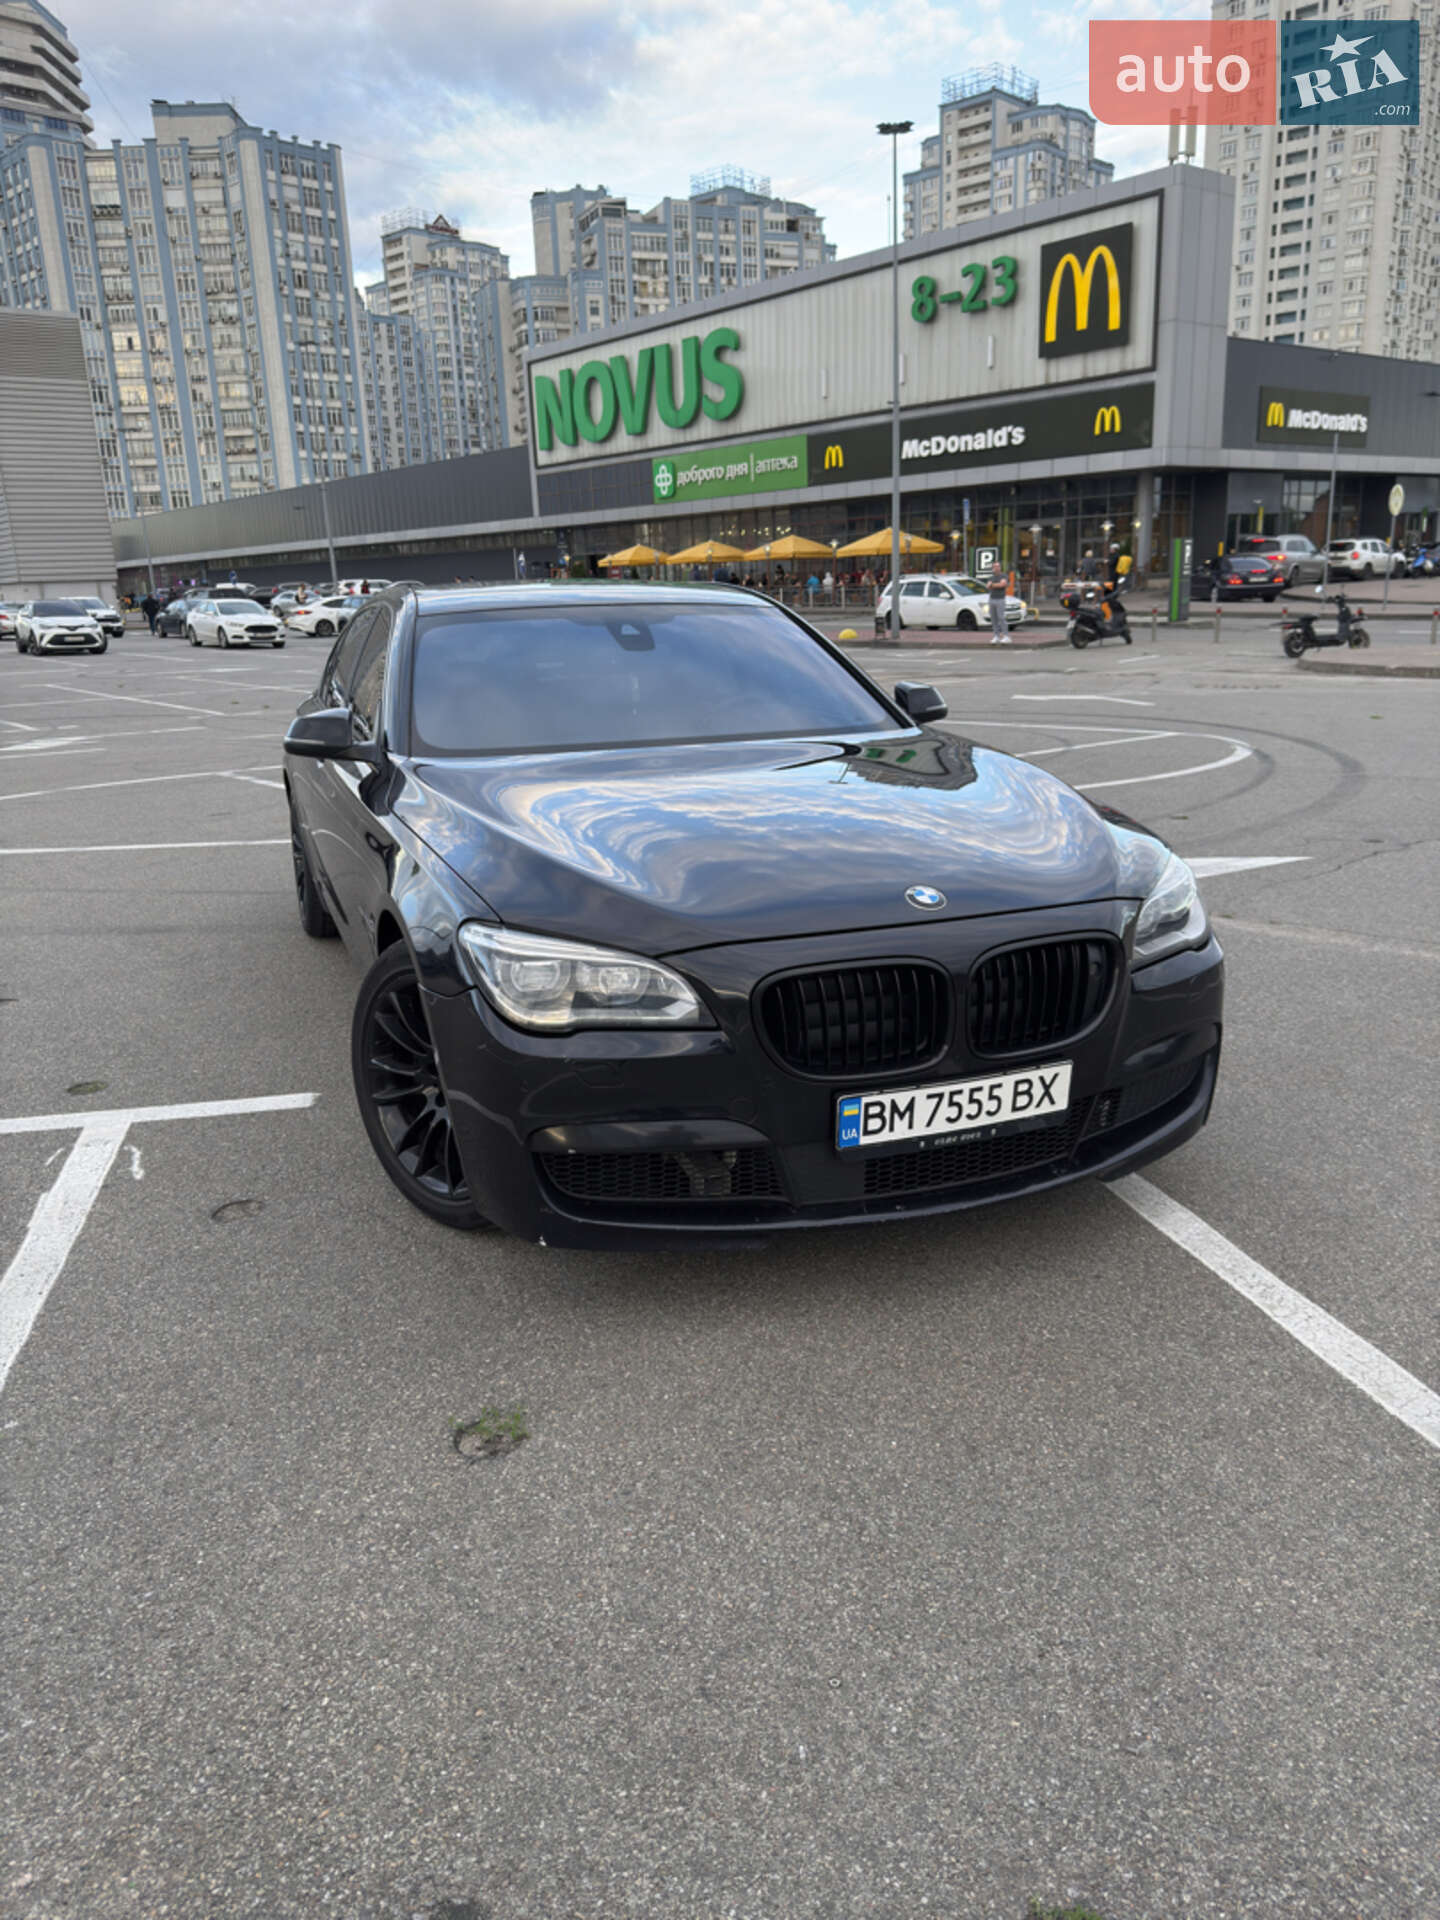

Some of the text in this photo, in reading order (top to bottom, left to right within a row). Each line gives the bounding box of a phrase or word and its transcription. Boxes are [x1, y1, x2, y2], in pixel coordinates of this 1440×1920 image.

[534, 326, 744, 452] NOVUS
[1287, 408, 1368, 433] McDonald's
[901, 424, 1026, 460] McDonald's
[676, 455, 798, 487] доброго дня аптека
[862, 1072, 1060, 1138] BM 7555 BX
[841, 1128, 859, 1140] UA
